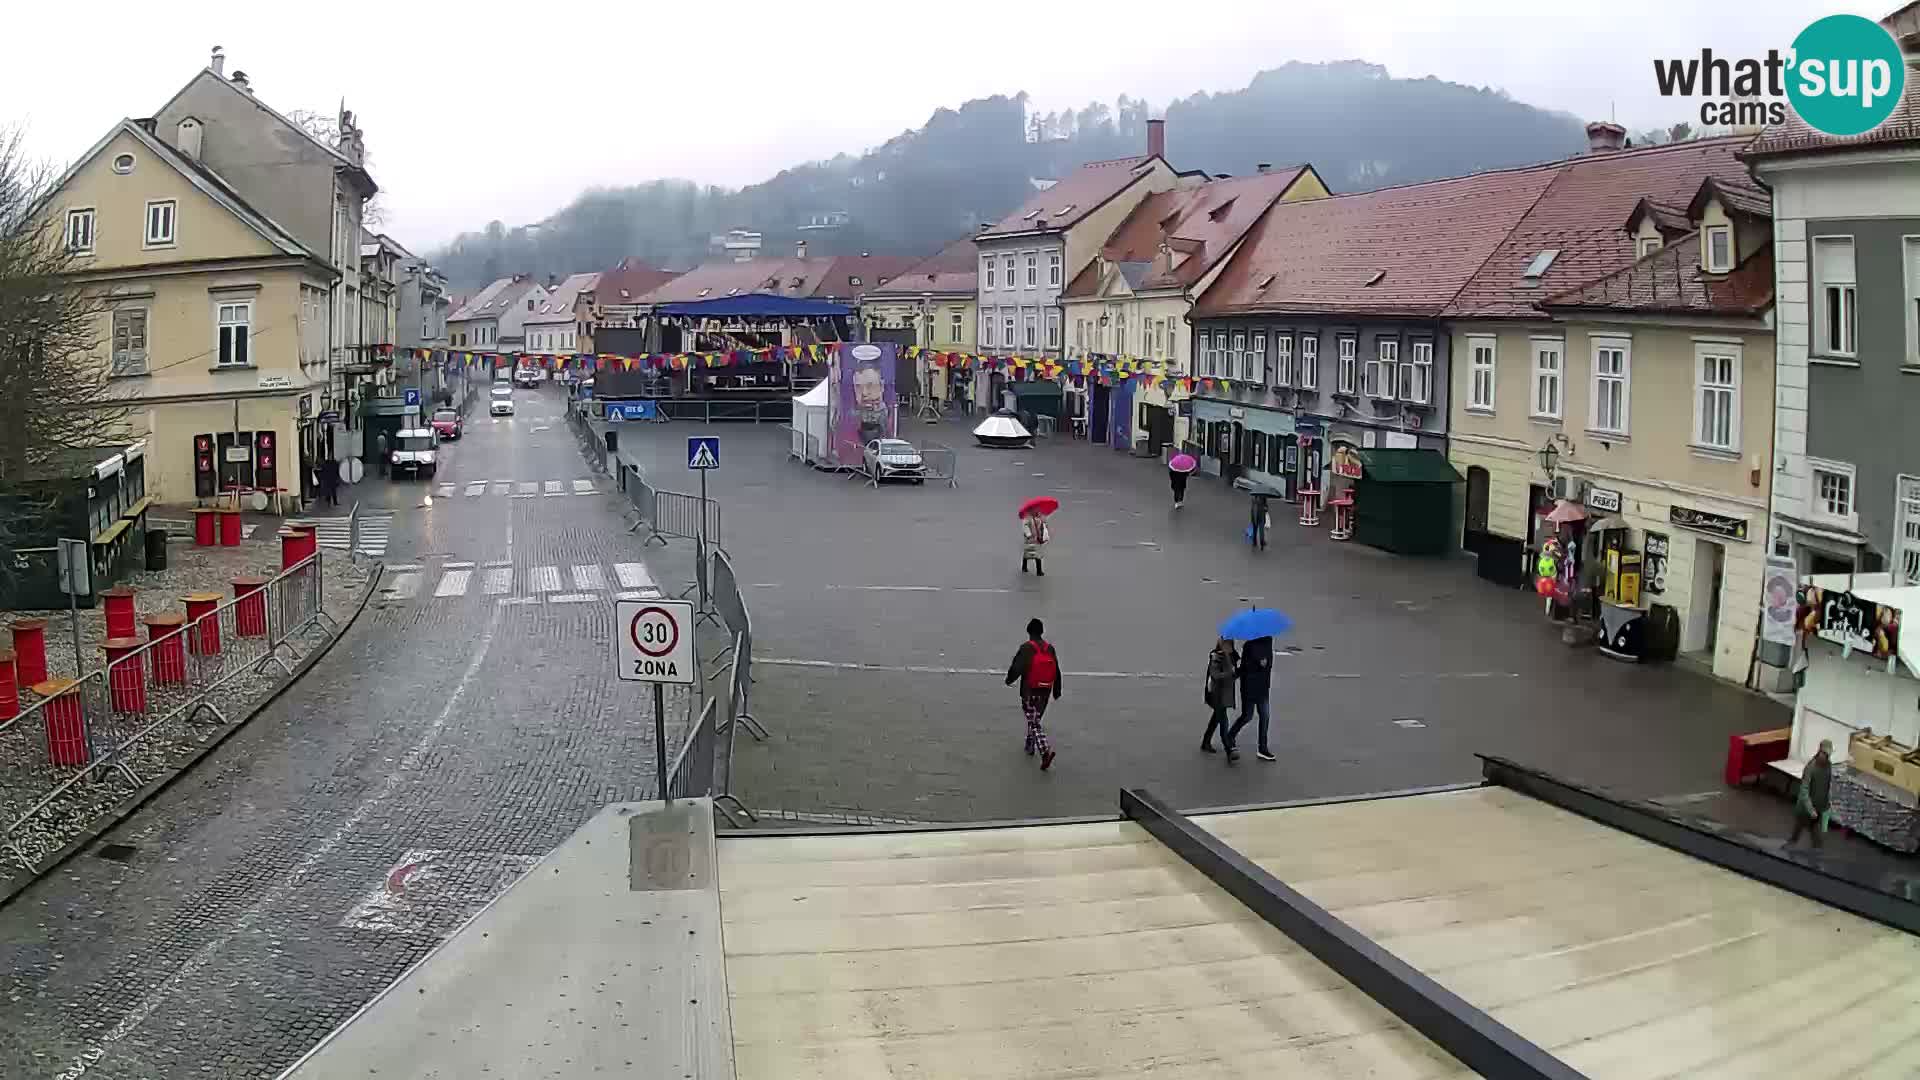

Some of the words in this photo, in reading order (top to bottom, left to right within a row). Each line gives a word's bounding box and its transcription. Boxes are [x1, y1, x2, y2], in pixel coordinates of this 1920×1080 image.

[408, 391, 416, 403] P
[643, 622, 667, 644] 30
[634, 659, 678, 676] ZONA
